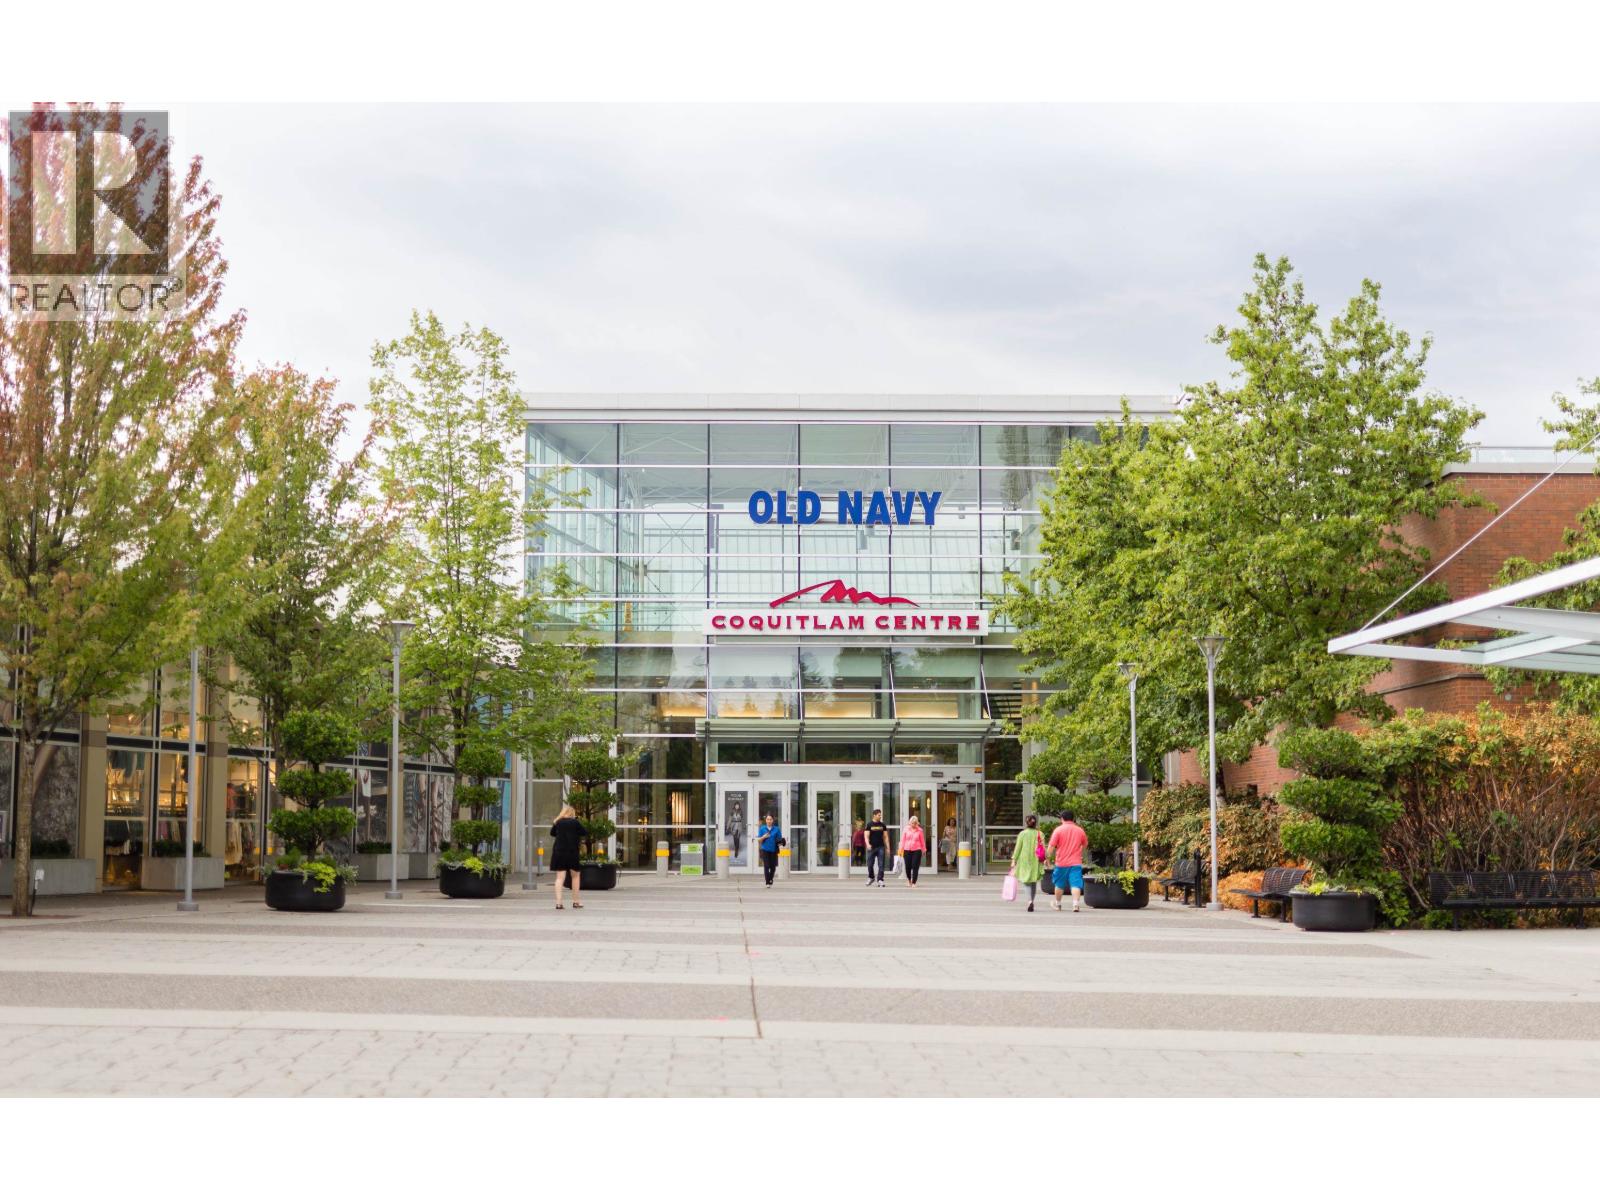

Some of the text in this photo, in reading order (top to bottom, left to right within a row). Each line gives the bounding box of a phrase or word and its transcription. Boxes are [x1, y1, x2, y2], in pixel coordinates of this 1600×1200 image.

[748, 490, 943, 526] OLD NAVY
[711, 615, 980, 632] COQUITLAM CENTRE
